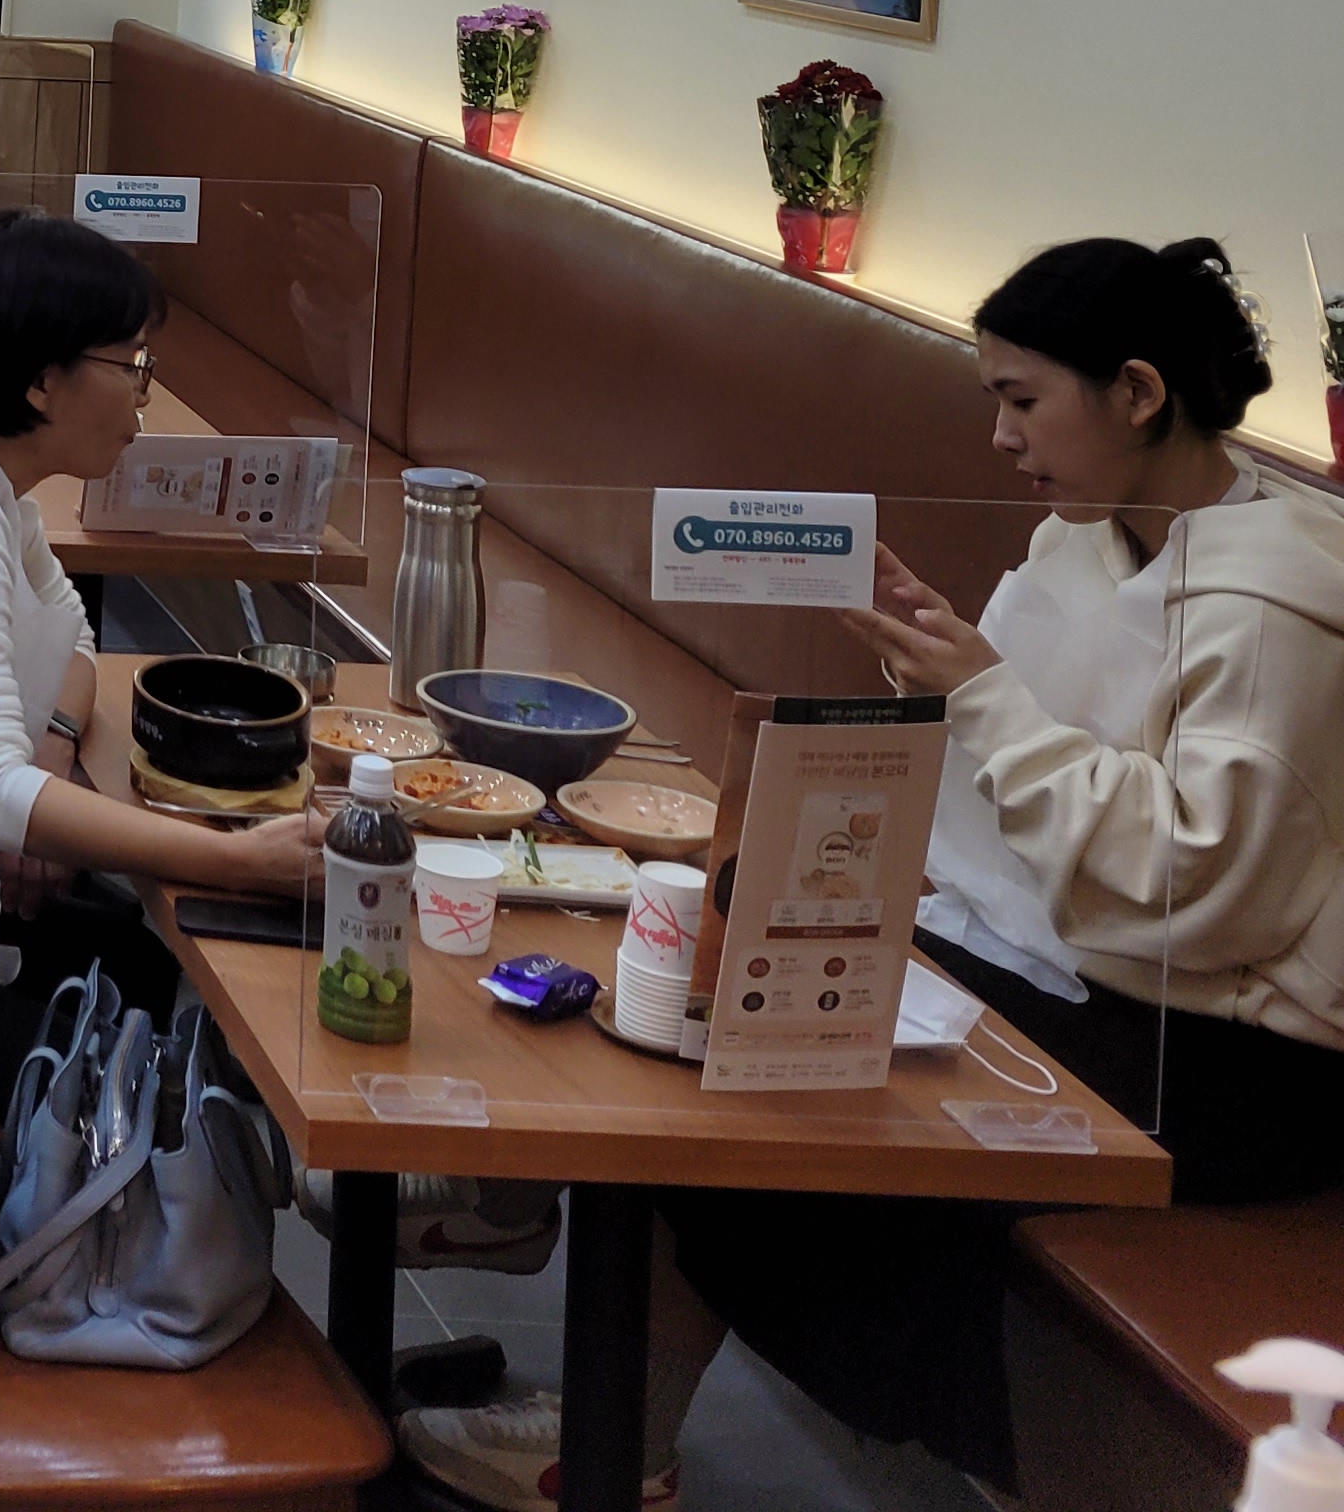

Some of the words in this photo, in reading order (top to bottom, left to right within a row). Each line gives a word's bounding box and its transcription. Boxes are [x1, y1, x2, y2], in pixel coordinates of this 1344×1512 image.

[116, 180, 159, 190] 출입관리전화
[107, 197, 182, 209] 070.8960.4526
[728, 500, 804, 516] 출입관리전화
[713, 528, 844, 548] 070.8960.4526
